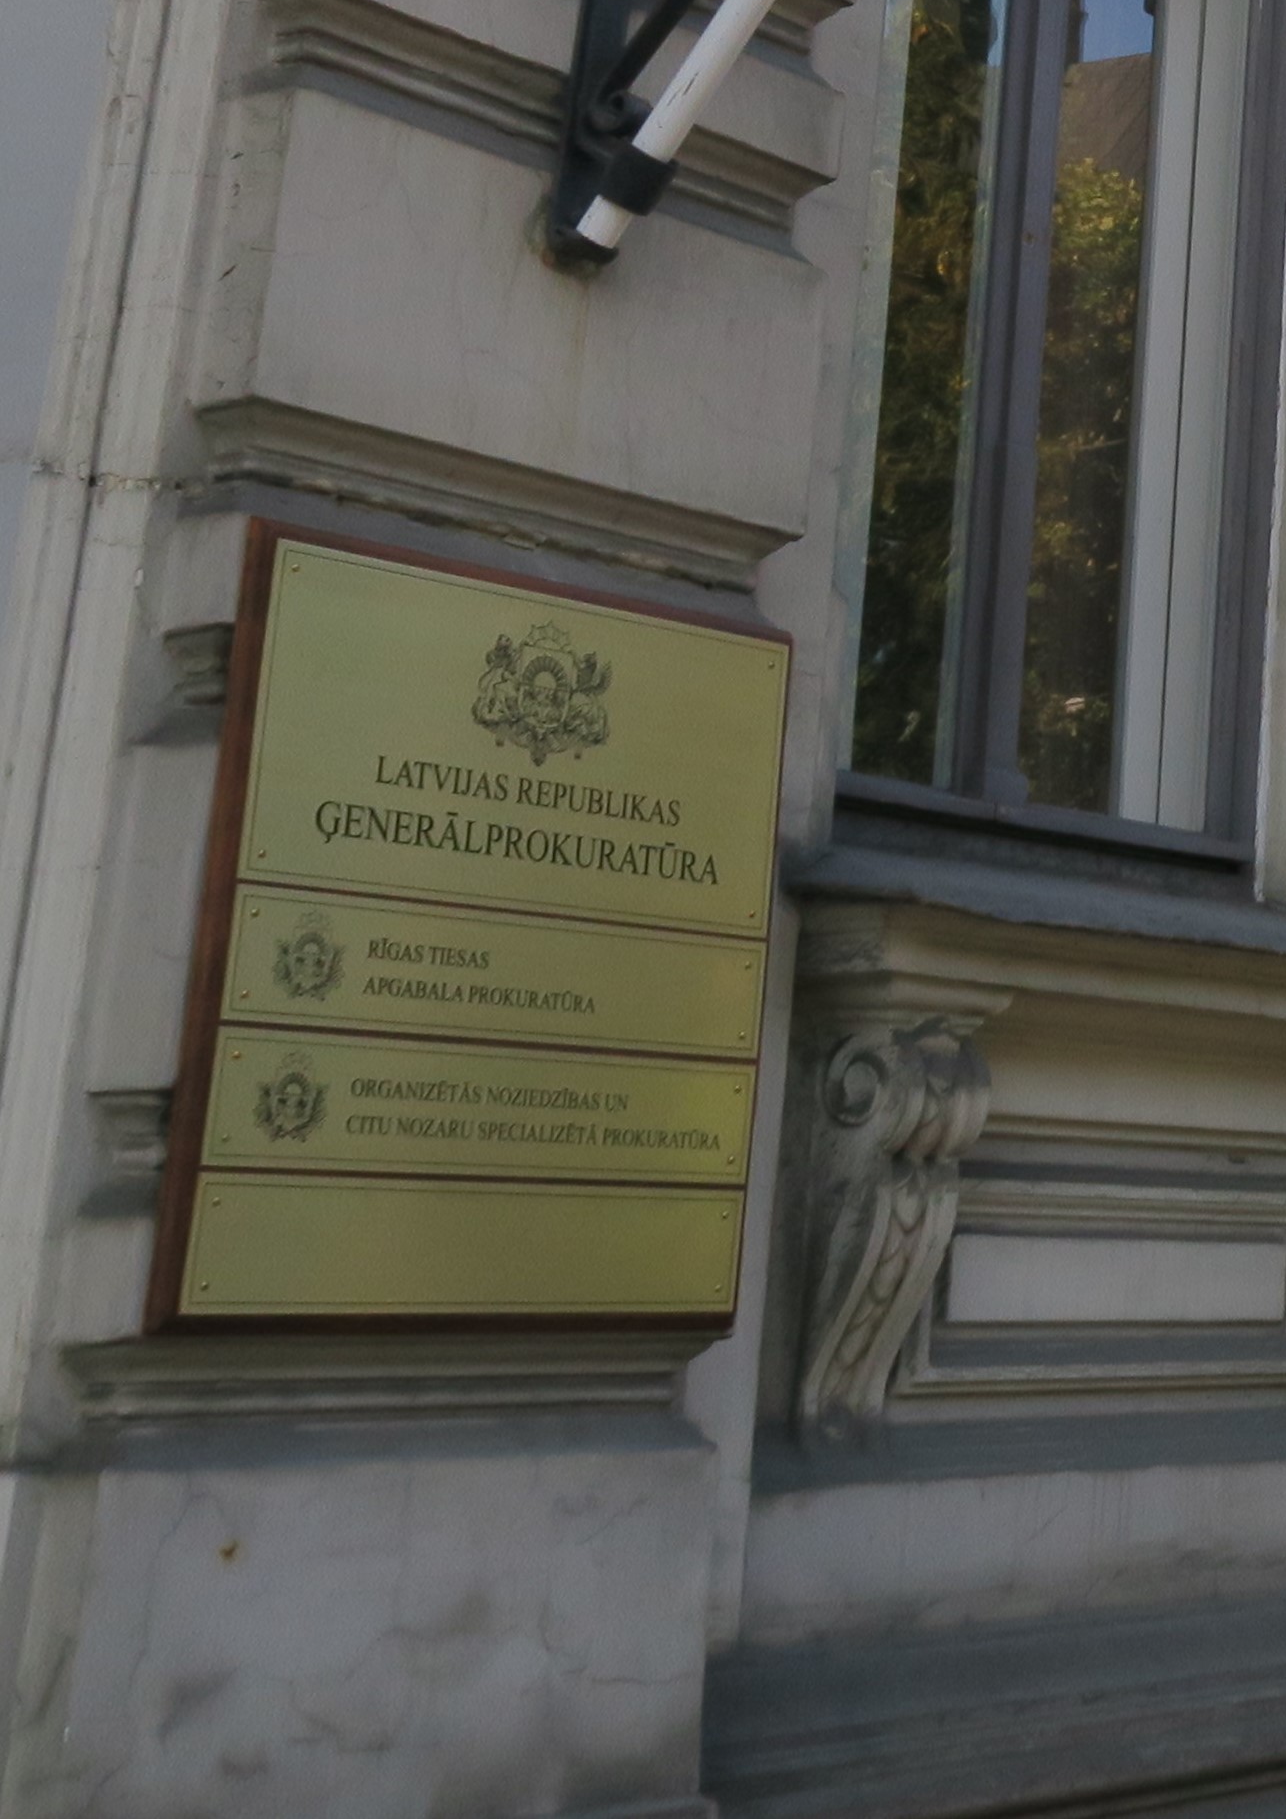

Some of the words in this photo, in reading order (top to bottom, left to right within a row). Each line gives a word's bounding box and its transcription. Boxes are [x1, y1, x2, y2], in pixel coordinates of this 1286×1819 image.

[375, 755, 509, 802] LATVIJAS
[516, 777, 681, 827] REPUBLIKAS
[314, 799, 720, 886] ĢENERĀLPROKURATŪRA
[366, 937, 425, 963] RĪGAS
[428, 945, 490, 970] TIESAS
[362, 976, 464, 1004] APGABALA
[467, 984, 596, 1015] PROKURATŪRA
[350, 1077, 482, 1105] ORGANIZĒTĀS
[486, 1085, 601, 1111] NOZIEDZĪBAS
[604, 1092, 630, 1112] UN
[345, 1114, 393, 1136] CITU
[396, 1117, 474, 1140] NOZARU
[477, 1120, 597, 1147] SPECIALIZĒTĀ
[601, 1126, 721, 1151] PROKURATŪRA
